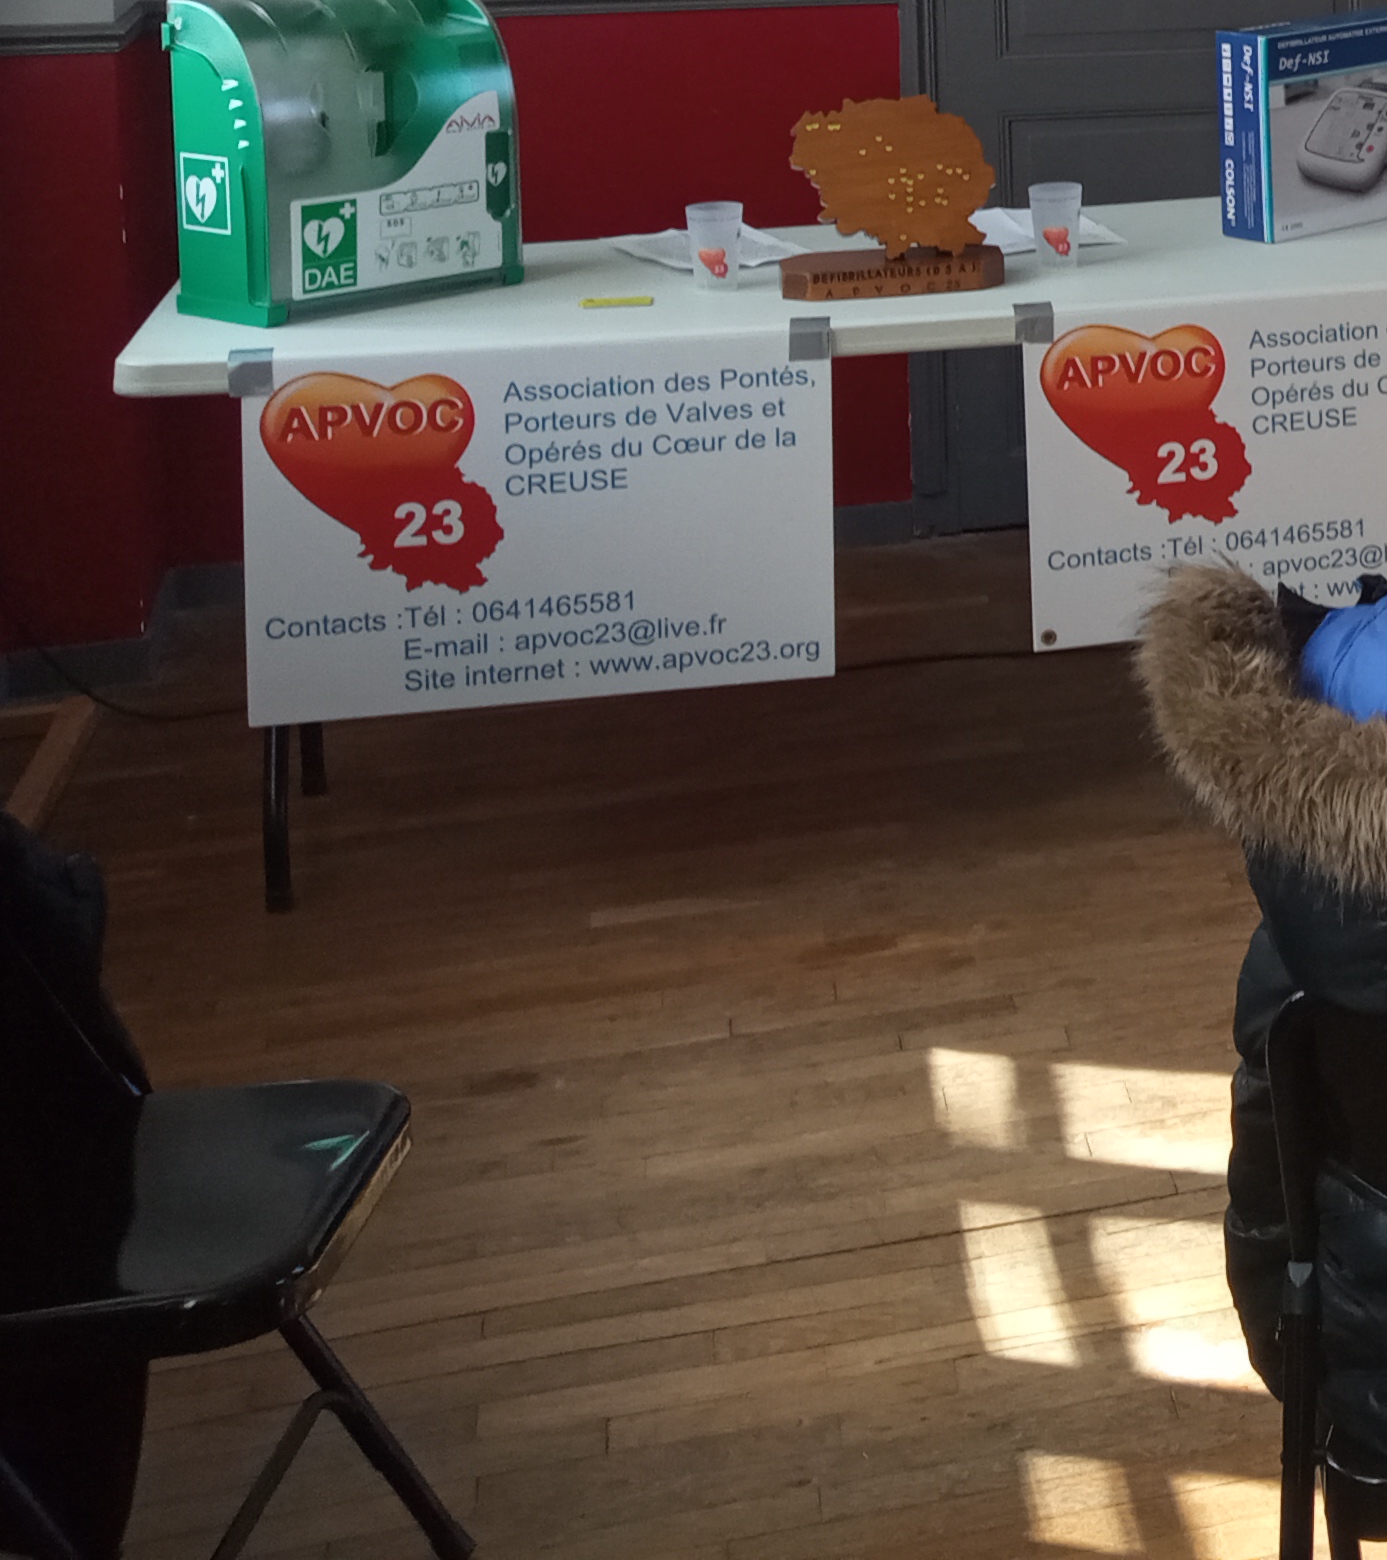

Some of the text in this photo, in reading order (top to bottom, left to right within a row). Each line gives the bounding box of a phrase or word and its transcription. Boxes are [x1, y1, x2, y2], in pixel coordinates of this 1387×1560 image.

[1241, 44, 1254, 113] Def-NSI
[1278, 49, 1331, 72] Def-NSI
[304, 263, 355, 291] DAE
[1249, 321, 1379, 350] Association
[503, 366, 816, 403] Association des Pontés,
[1057, 344, 1216, 391] APVOC
[1250, 353, 1346, 379] Porteurs
[1353, 348, 1381, 369] de
[1251, 380, 1335, 410] Opérés
[1341, 378, 1369, 399] du
[277, 397, 464, 444] APVOC
[505, 397, 786, 434] Porteurs de Valves et
[1252, 406, 1358, 435] CREUSE
[505, 427, 797, 469] Opérés du Cœur de la
[1157, 438, 1219, 485] 23
[505, 467, 629, 497] CREUSE
[393, 499, 465, 548] 23
[1047, 542, 1153, 571] Contacts
[1225, 518, 1365, 552] 0641465581
[265, 612, 387, 640] Contacts
[472, 590, 635, 624] 0641465581
[404, 632, 489, 661] E-mail
[514, 613, 727, 655] apvoc23@live.fr
[404, 669, 455, 692] Site
[465, 658, 565, 687] internet
[589, 640, 820, 675] www.apvoc23.org
